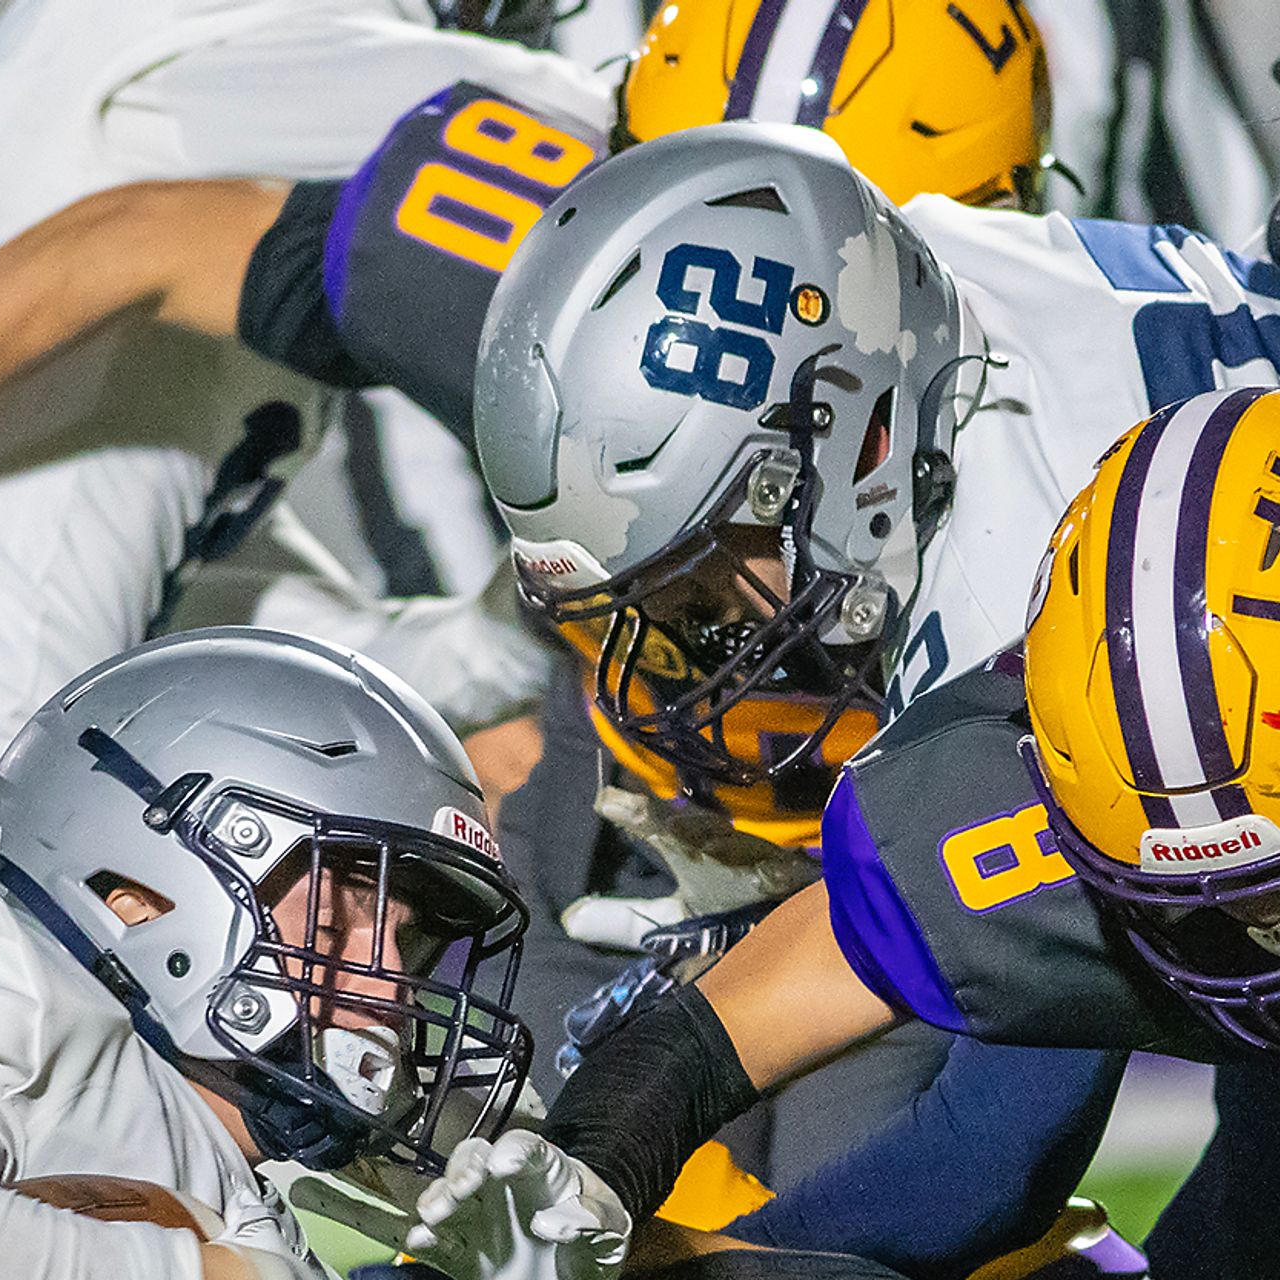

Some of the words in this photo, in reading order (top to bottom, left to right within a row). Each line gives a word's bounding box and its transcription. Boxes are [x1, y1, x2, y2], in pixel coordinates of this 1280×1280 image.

[394, 98, 596, 274] 80
[639, 243, 796, 413] 82
[1150, 829, 1262, 863] Riddell
